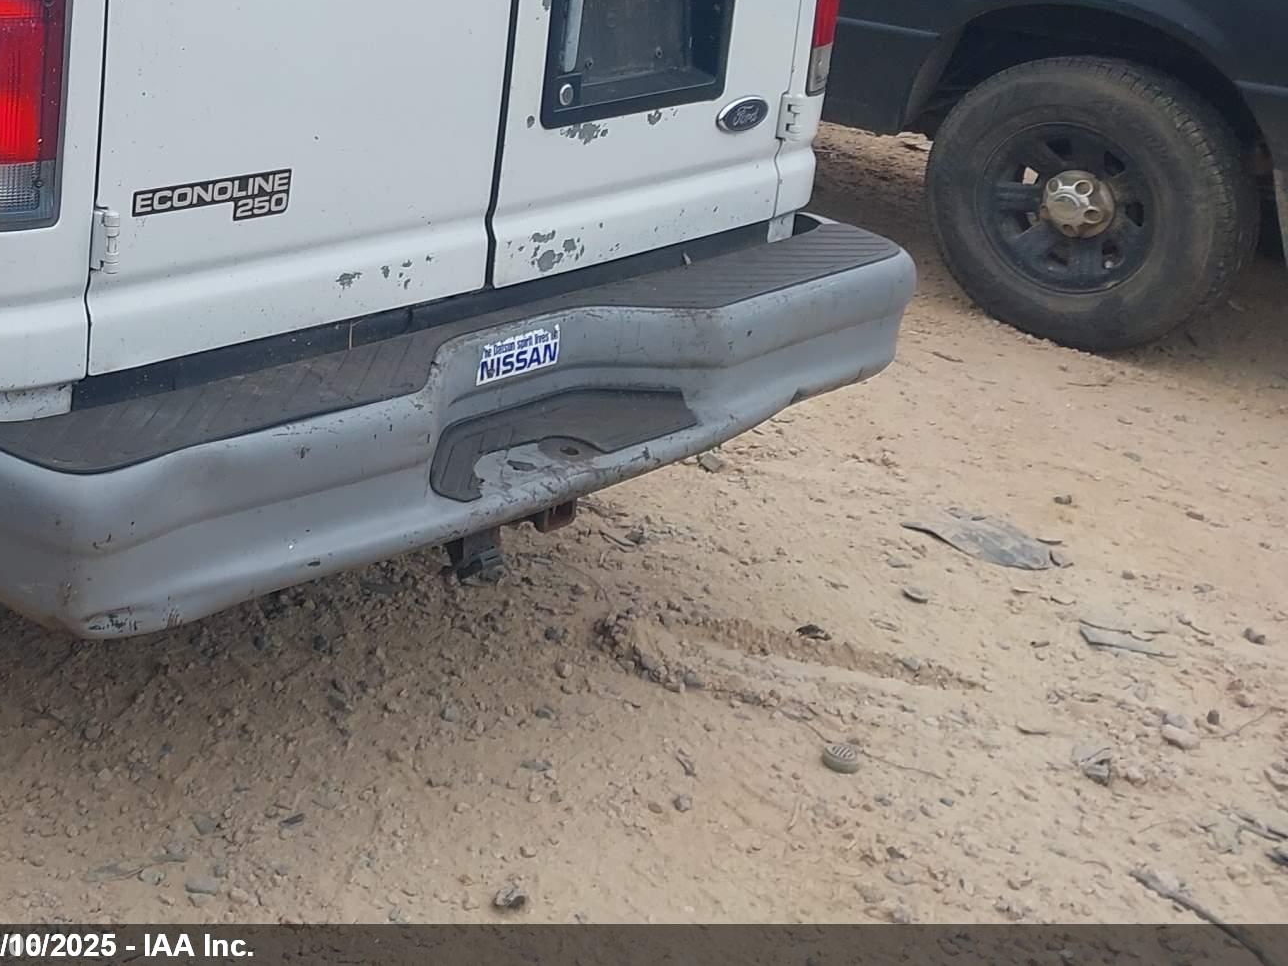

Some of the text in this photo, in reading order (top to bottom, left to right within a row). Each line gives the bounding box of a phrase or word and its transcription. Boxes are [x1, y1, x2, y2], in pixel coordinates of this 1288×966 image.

[732, 104, 760, 127] Ford
[135, 172, 290, 214] ECONOLINE
[235, 192, 288, 218] 250
[480, 342, 558, 381] NISSAN
